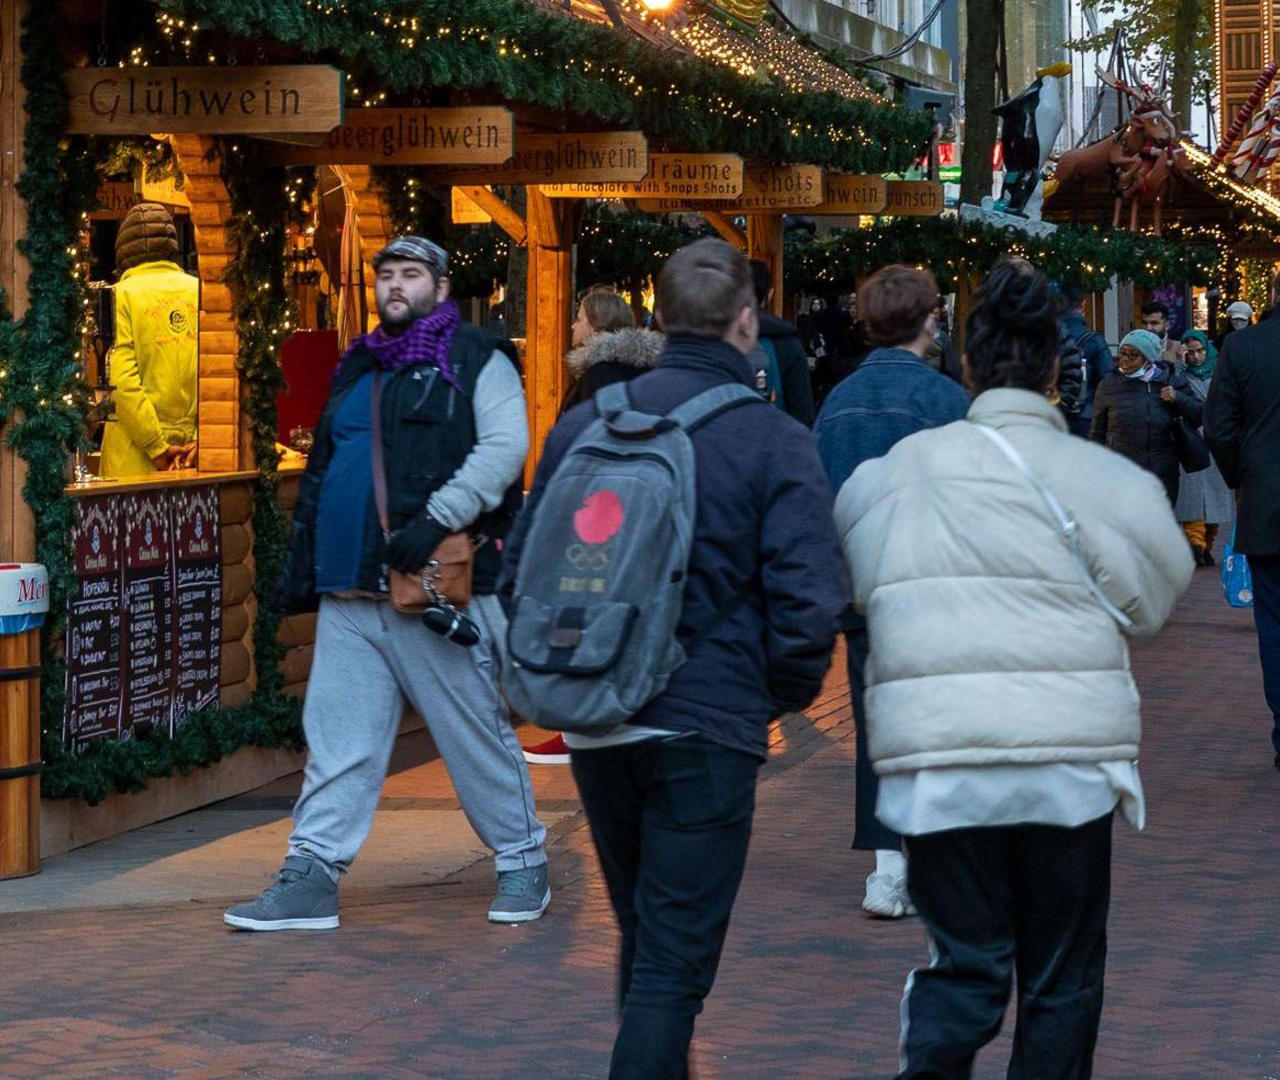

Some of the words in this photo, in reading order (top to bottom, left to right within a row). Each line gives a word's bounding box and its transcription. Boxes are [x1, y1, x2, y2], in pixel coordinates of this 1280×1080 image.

[89, 75, 301, 122] Glühwein
[634, 182, 660, 194] with
[704, 182, 738, 195] Shots
[760, 172, 813, 193] Shots
